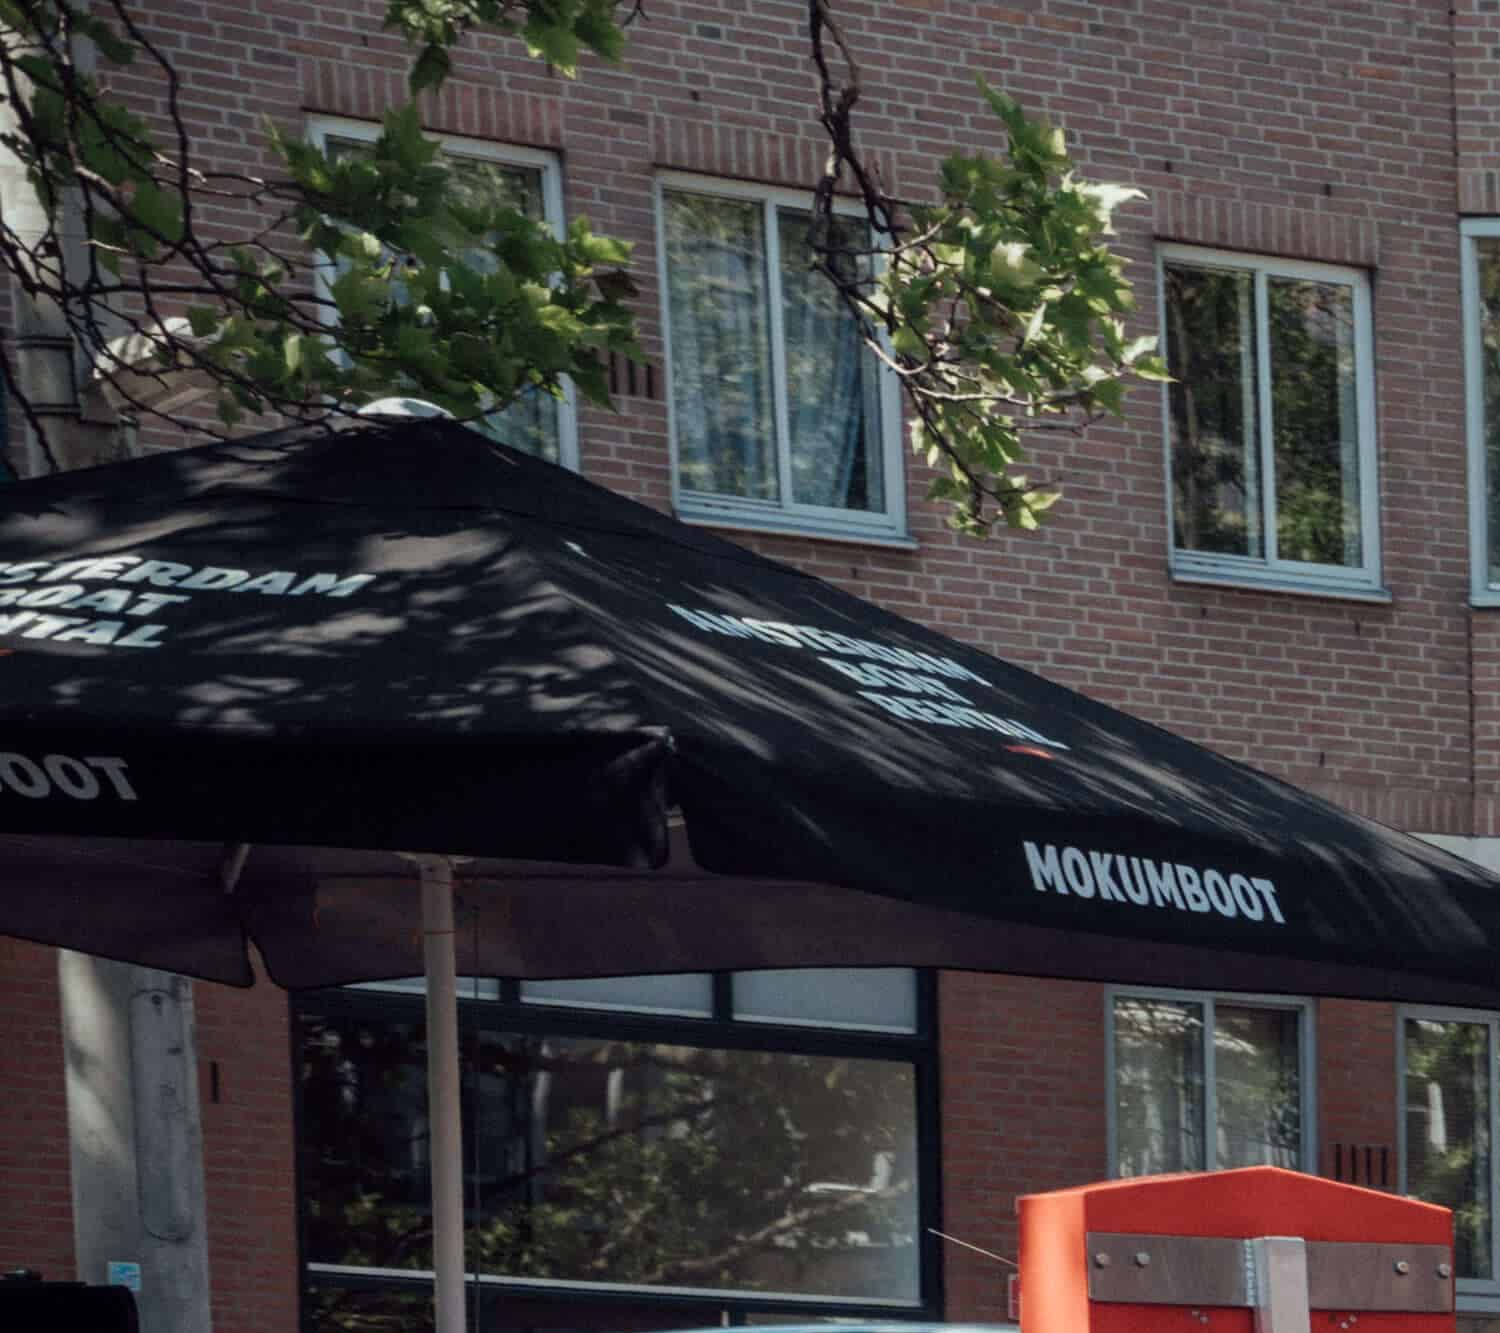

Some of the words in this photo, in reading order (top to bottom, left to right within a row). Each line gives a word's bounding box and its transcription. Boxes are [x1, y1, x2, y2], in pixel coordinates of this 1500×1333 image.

[0, 555, 377, 598] STERDAM
[665, 602, 994, 688] AMSTERDAM
[817, 655, 976, 707] BOAT
[856, 690, 1072, 751] RENTAL
[0, 751, 138, 801] OOT
[1023, 840, 1286, 924] MOKUMBOOT
